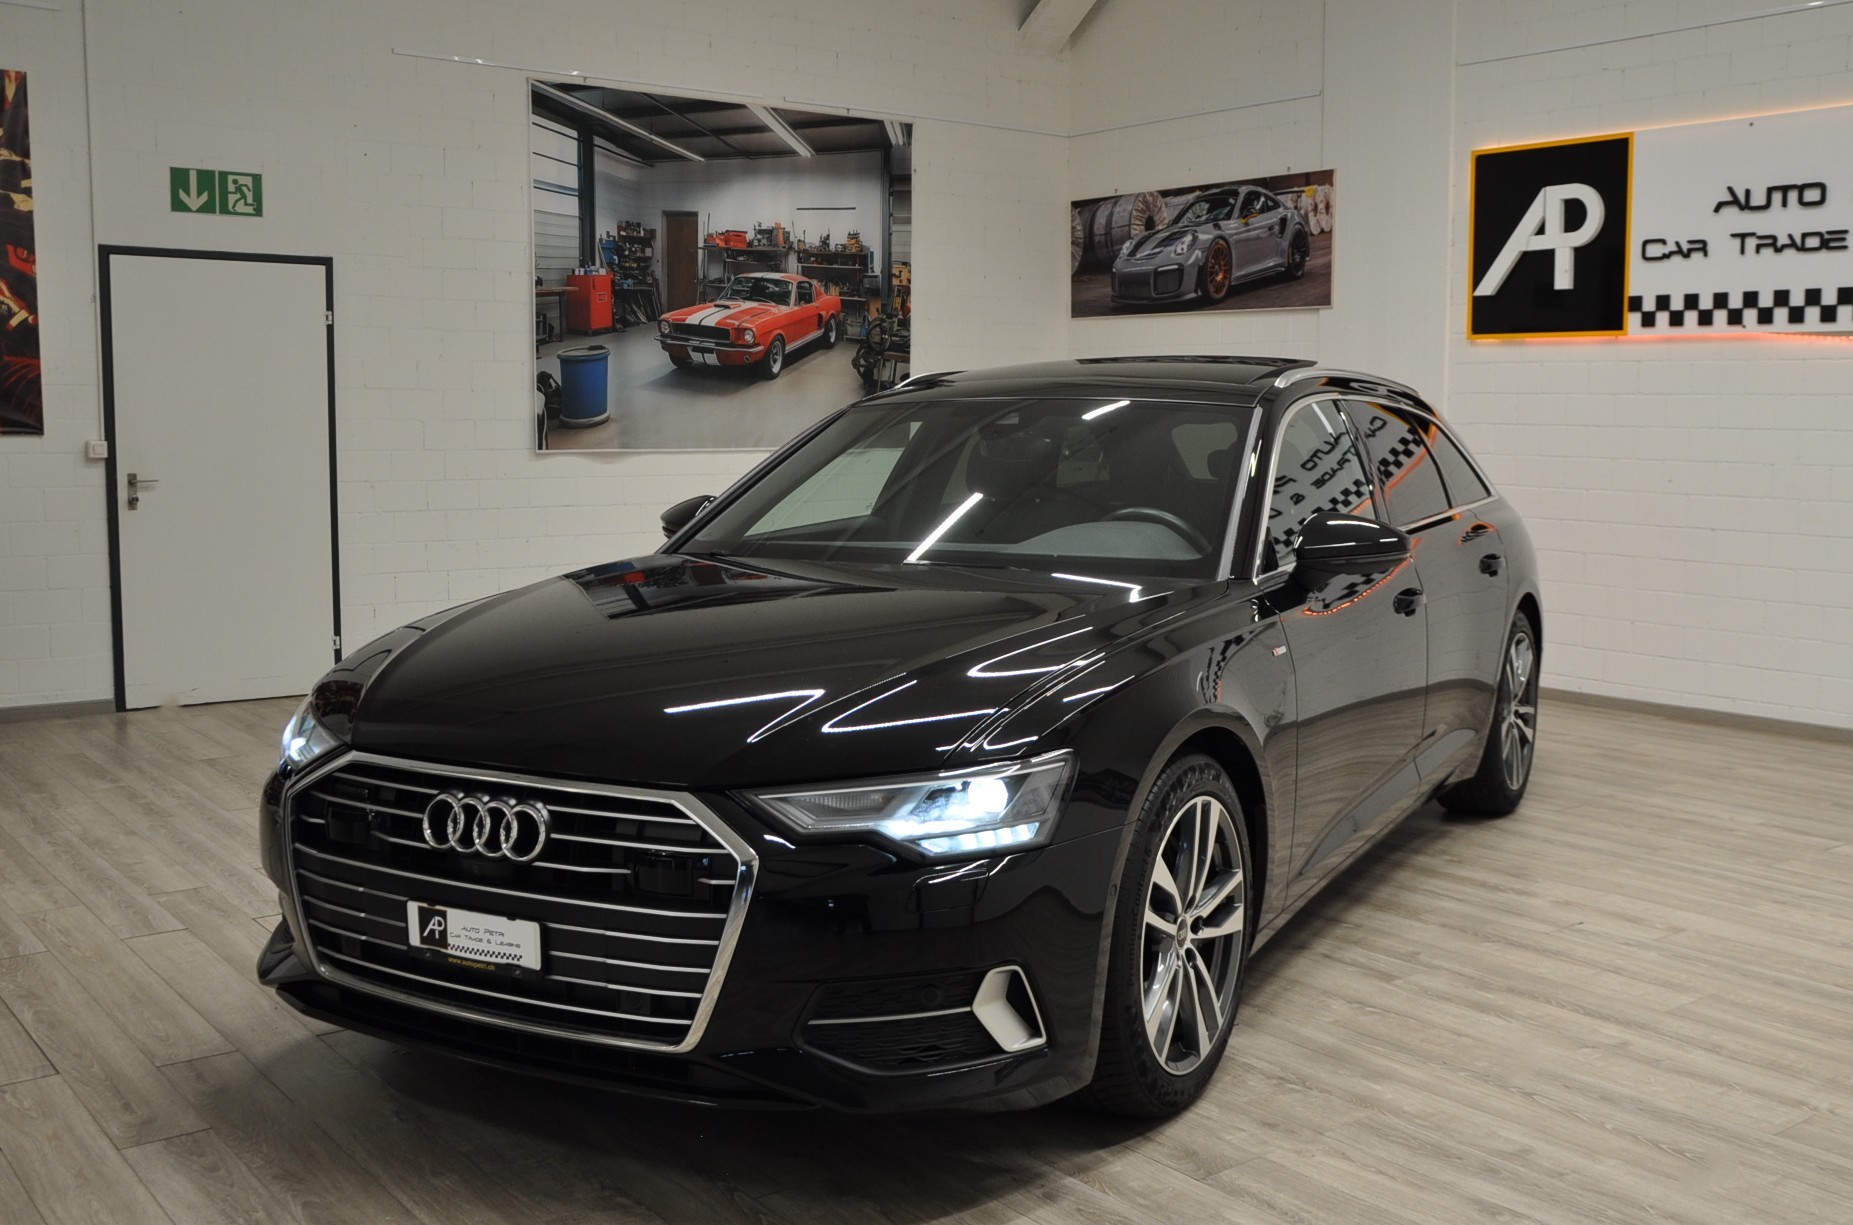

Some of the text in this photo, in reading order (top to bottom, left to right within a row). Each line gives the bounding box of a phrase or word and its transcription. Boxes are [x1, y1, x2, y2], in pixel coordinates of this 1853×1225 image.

[1713, 181, 1827, 213] AUTO
[1641, 229, 1850, 262] CAR TRADE
[461, 925, 480, 934] AUTO
